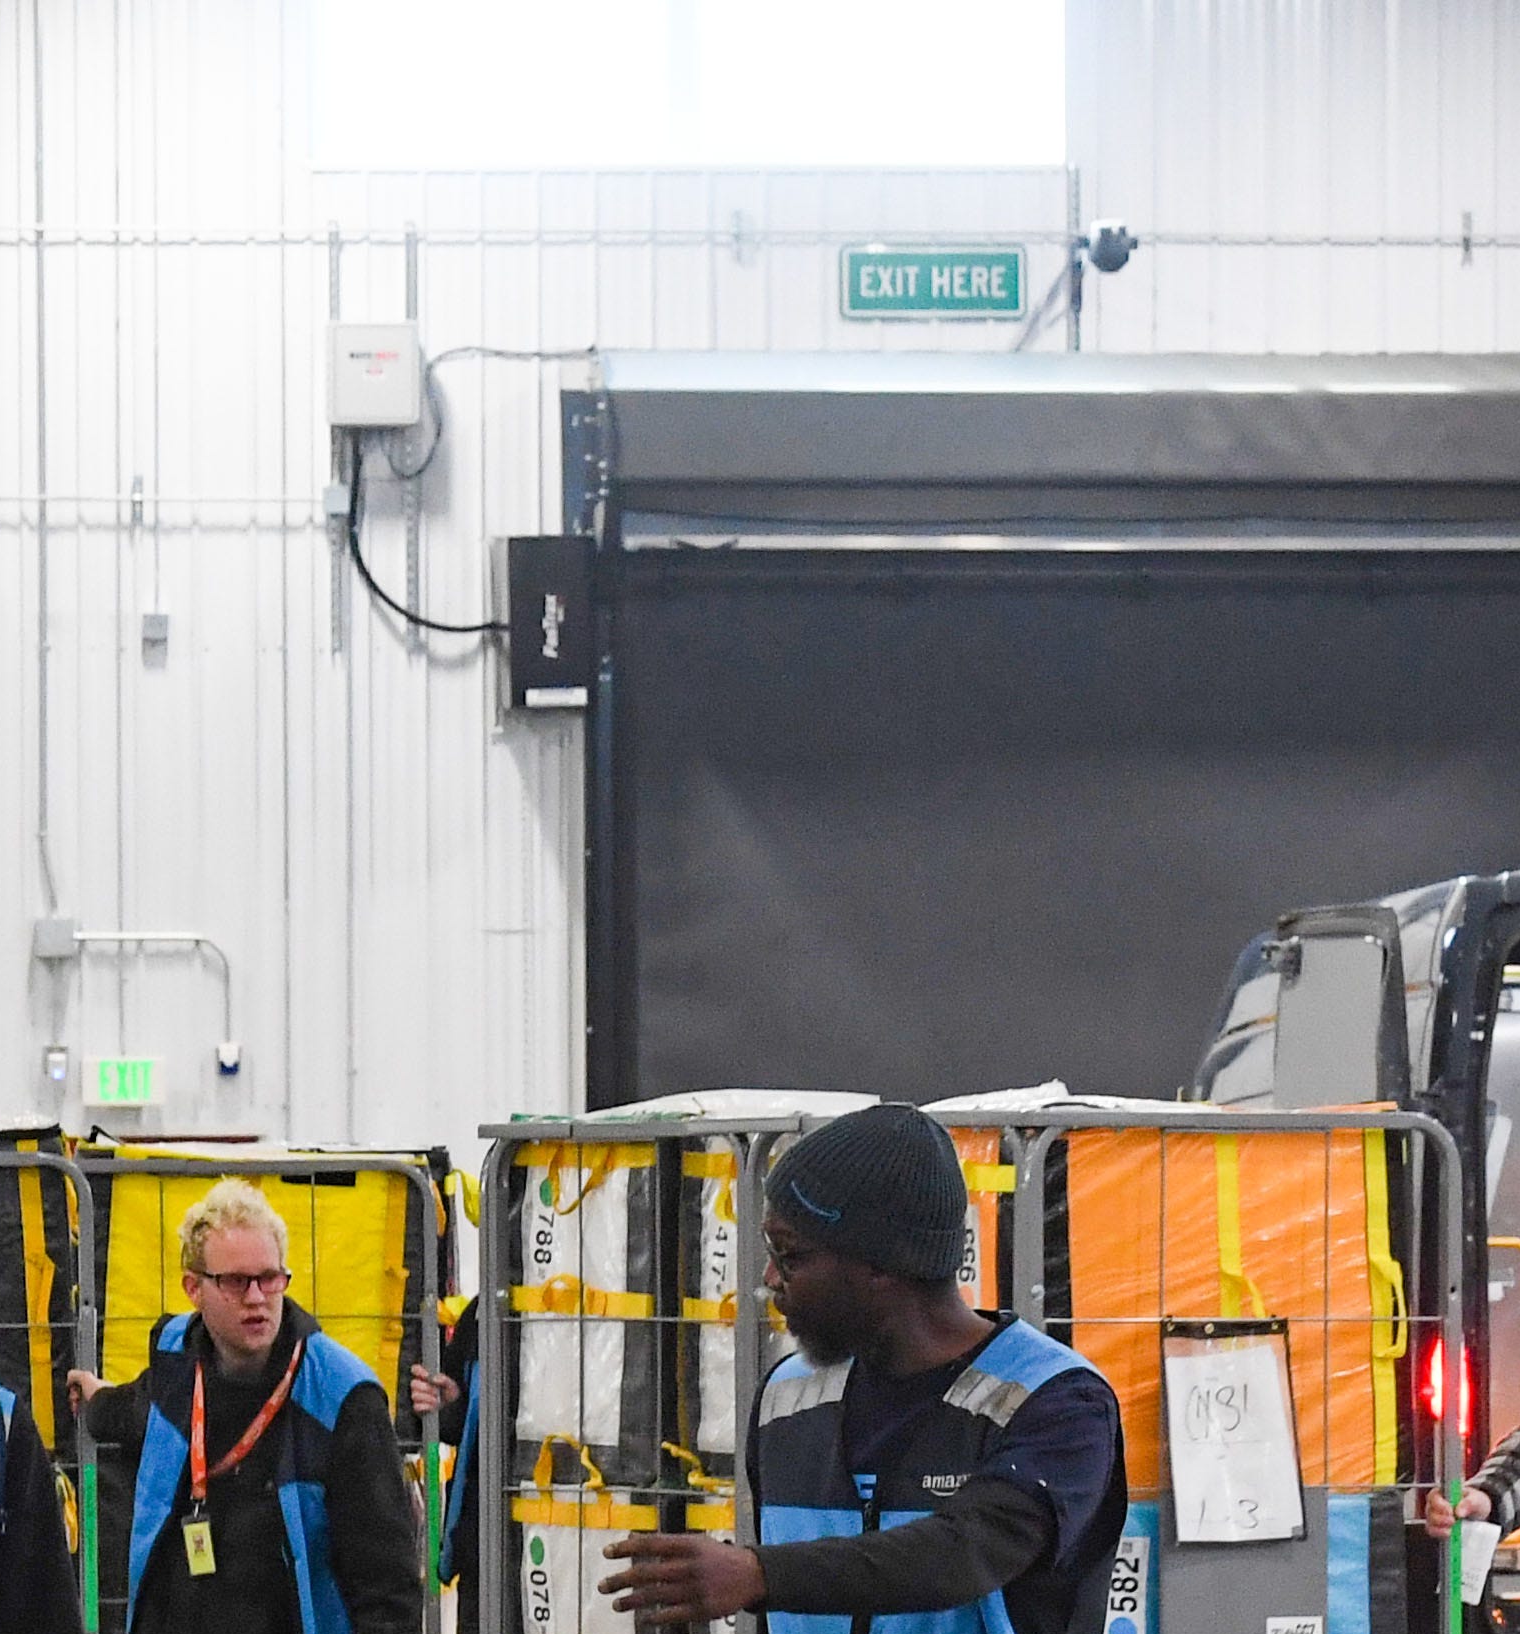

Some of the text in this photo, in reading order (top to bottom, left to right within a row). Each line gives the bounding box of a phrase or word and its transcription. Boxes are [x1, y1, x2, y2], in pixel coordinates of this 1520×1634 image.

[859, 265, 1007, 299] EXIT HERE
[98, 1060, 154, 1102] EXIT
[534, 1212, 555, 1265] 788
[712, 1226, 728, 1282] 417
[1238, 1498, 1260, 1529] 3
[530, 1570, 551, 1622] 078
[1110, 1557, 1140, 1613] 582
